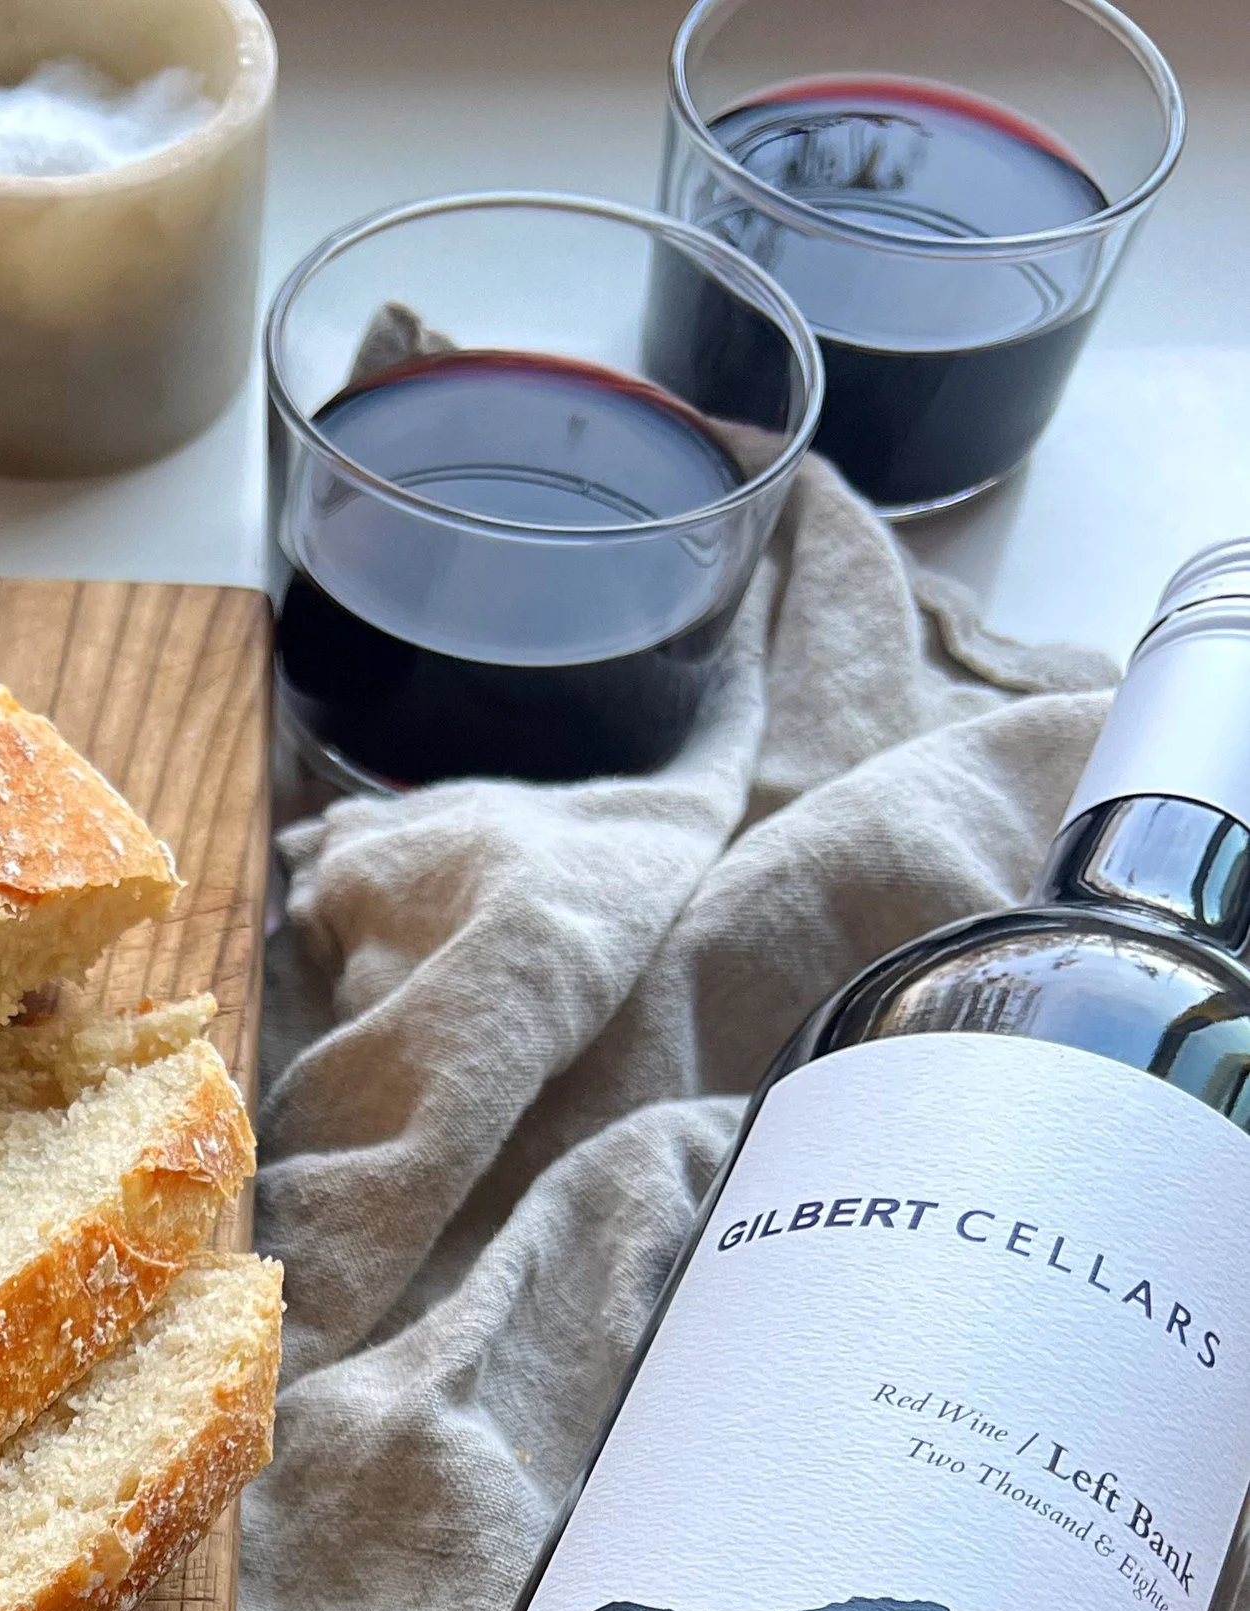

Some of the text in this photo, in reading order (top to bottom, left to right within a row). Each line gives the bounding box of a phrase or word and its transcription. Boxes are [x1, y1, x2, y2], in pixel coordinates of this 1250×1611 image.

[717, 1197, 1222, 1370] GILBERT CELLARS
[871, 1382, 1197, 1597] Red Wine / Left Bank
[907, 1436, 967, 1475] Two
[977, 1461, 1095, 1543] Thousand
[1095, 1535, 1117, 1557] &
